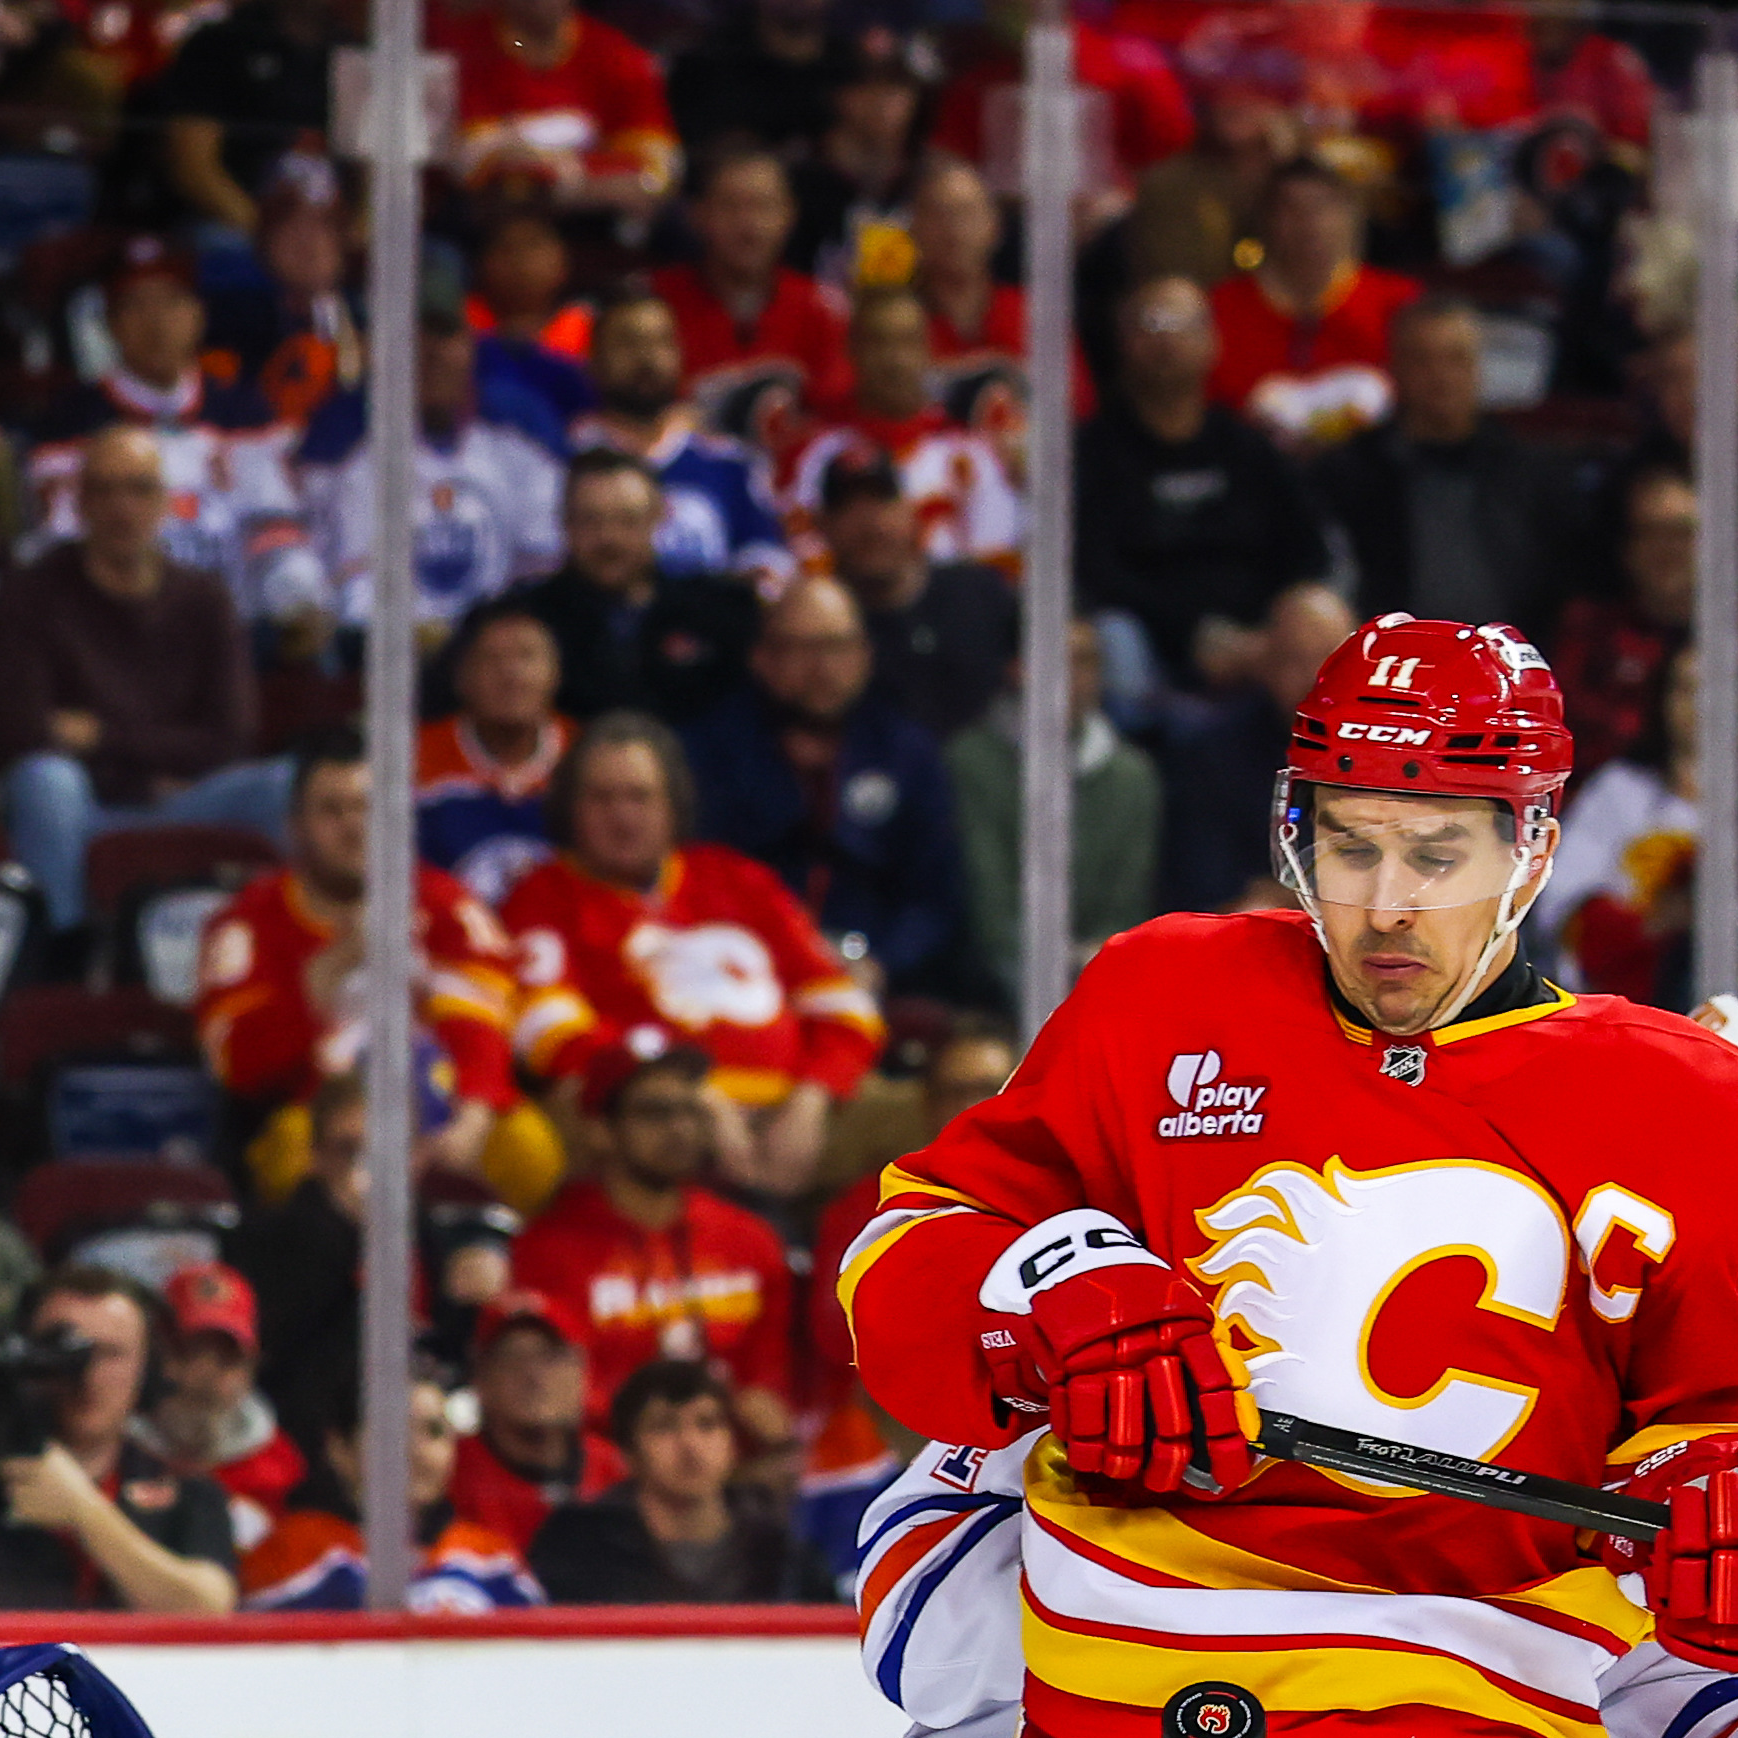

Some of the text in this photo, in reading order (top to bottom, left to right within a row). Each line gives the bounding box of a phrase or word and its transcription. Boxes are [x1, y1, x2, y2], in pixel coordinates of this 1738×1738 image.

[1367, 655, 1422, 689] 11
[1336, 721, 1432, 746] CCM
[1194, 1082, 1266, 1113] play
[1157, 1110, 1264, 1138] alberta
[1572, 1181, 1676, 1324] C
